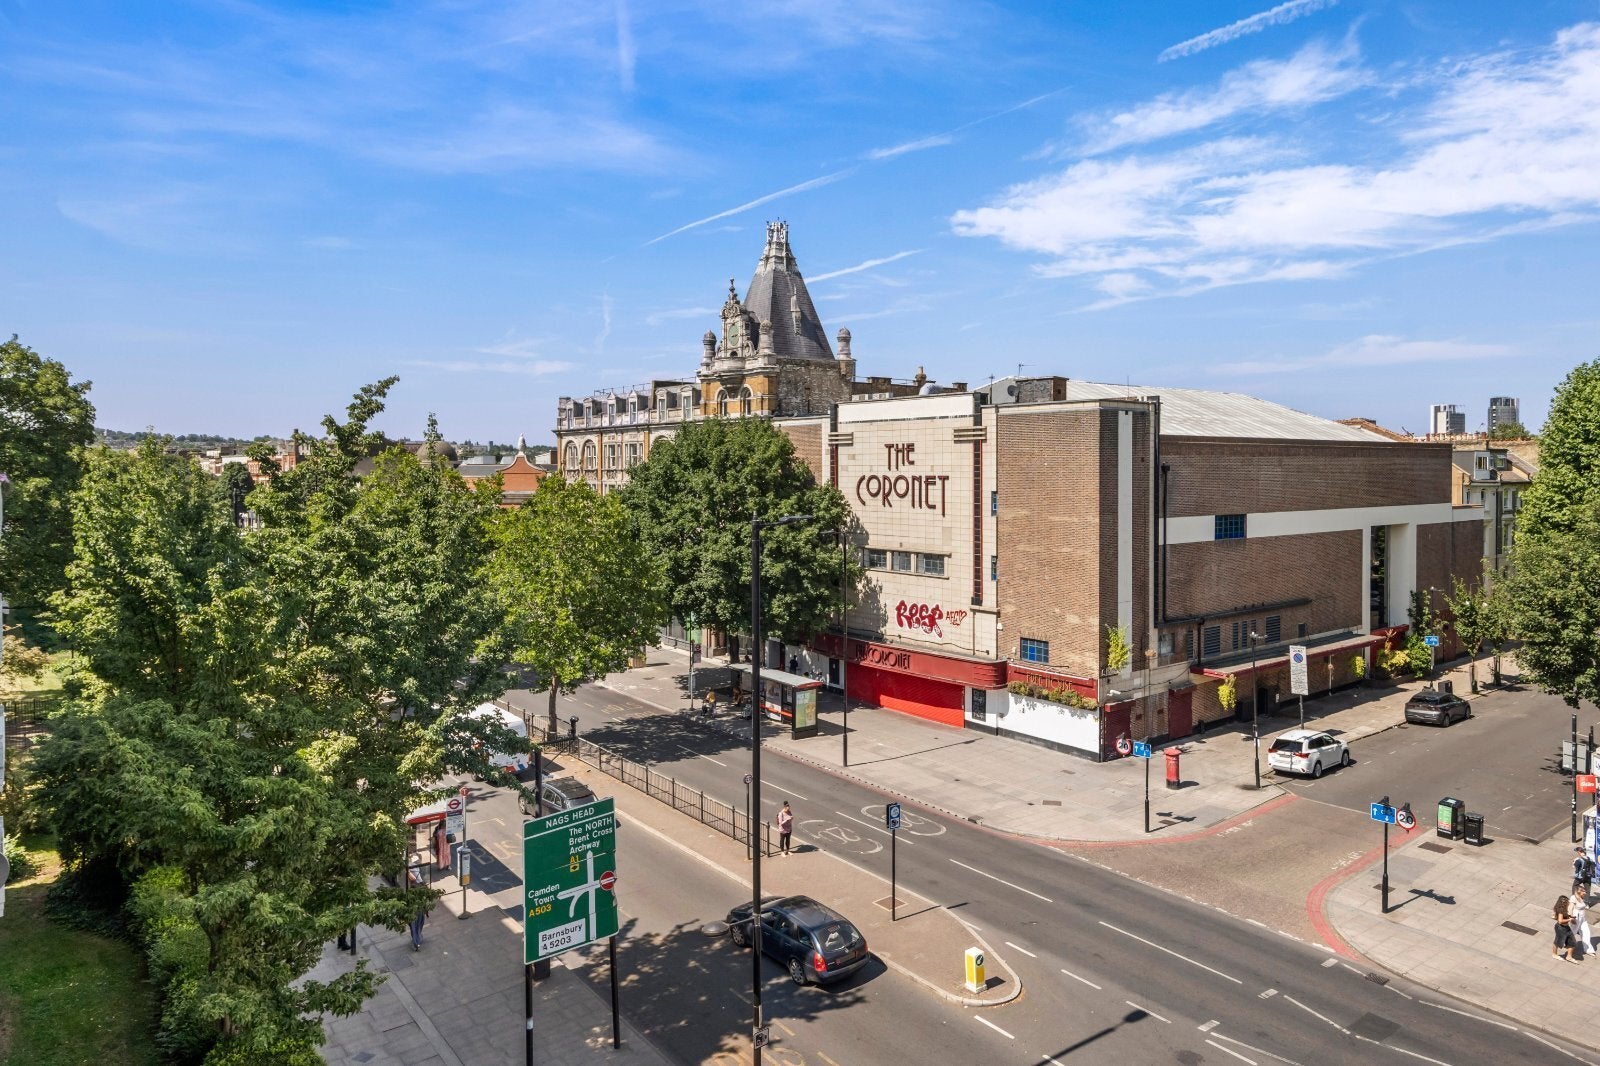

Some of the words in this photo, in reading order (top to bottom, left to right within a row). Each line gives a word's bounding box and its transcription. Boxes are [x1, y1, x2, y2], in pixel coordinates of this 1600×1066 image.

[884, 443, 915, 471] THE
[856, 474, 949, 518] CORONET
[867, 647, 911, 670] CORONET
[545, 814, 570, 829] NAGS
[572, 807, 595, 821] HEAD
[569, 826, 583, 836] The
[585, 817, 613, 831] NORTH
[1399, 813, 1414, 824] 20
[569, 833, 590, 846] Brent
[592, 827, 613, 838] Cross
[569, 840, 600, 855] Archway
[569, 855, 579, 864] A1
[528, 882, 560, 899] Camden
[533, 894, 555, 906] Town
[528, 904, 552, 918] A503
[541, 923, 583, 942] Barnsbury
